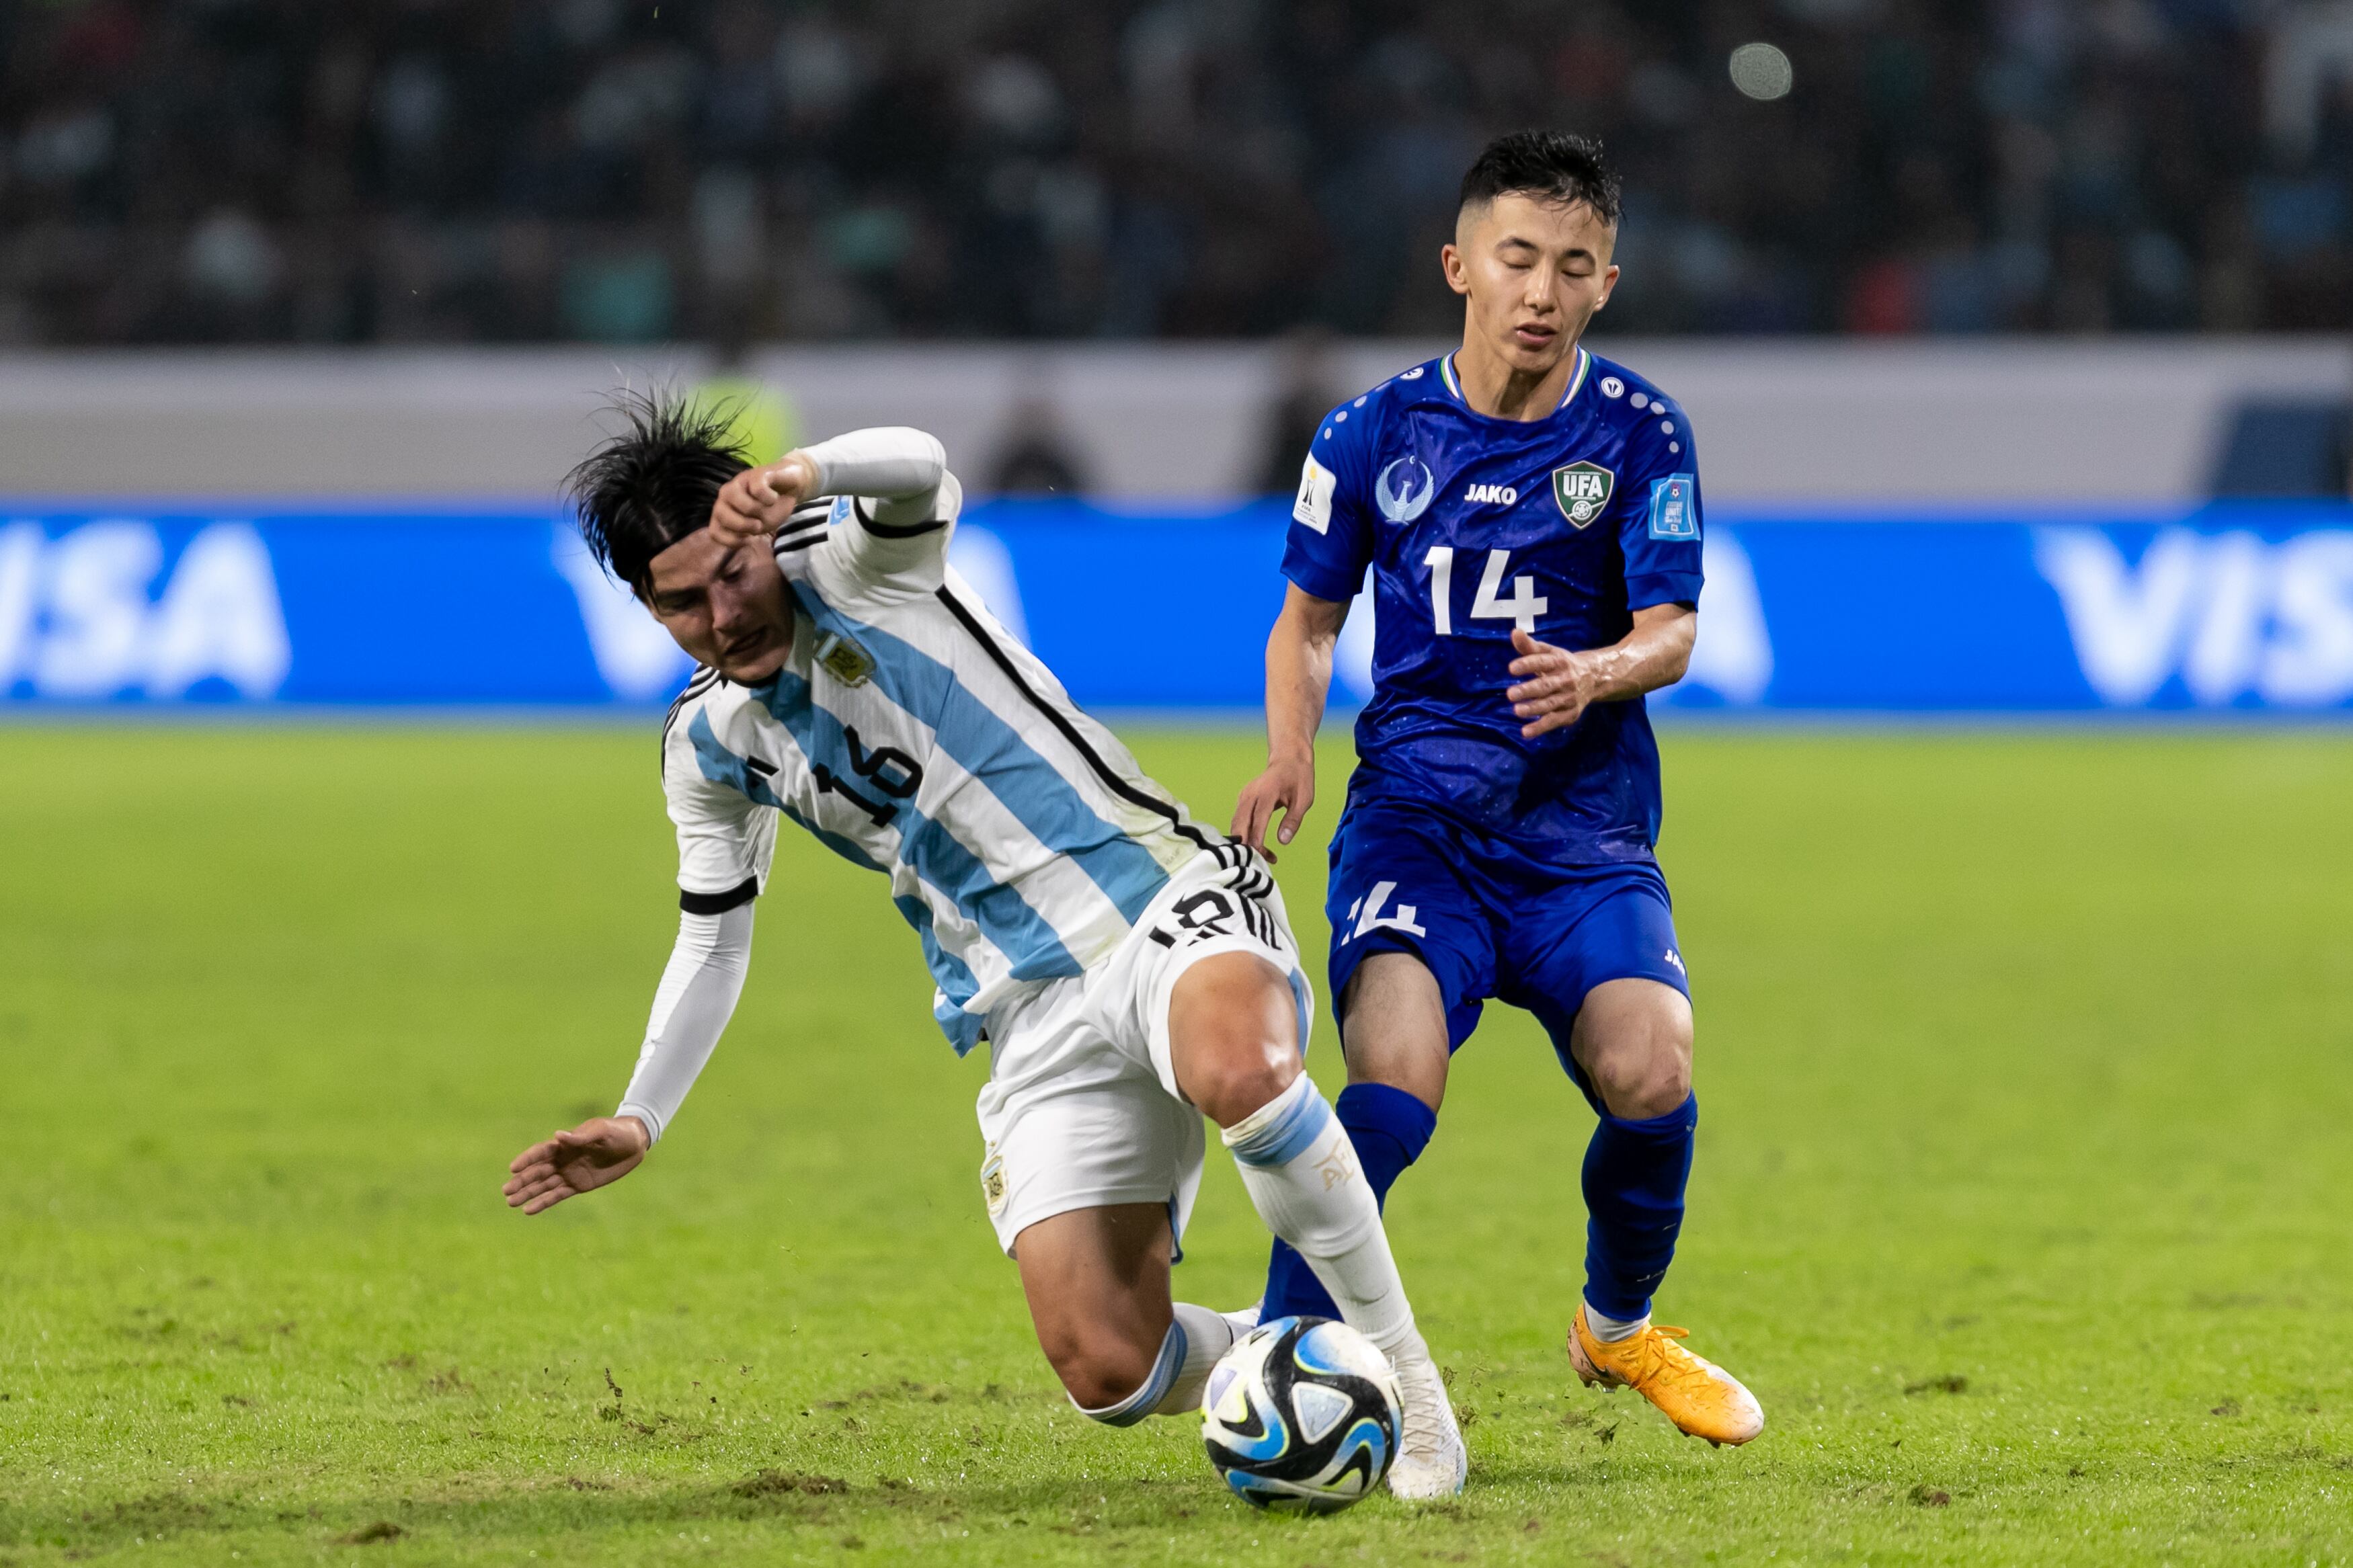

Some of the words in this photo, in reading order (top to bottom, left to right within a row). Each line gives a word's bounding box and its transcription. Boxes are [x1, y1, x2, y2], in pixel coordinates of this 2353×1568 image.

[1464, 483, 1517, 505] JAKO
[1563, 474, 1604, 497] UFA
[1424, 546, 1548, 635] 14
[811, 724, 923, 828] 16
